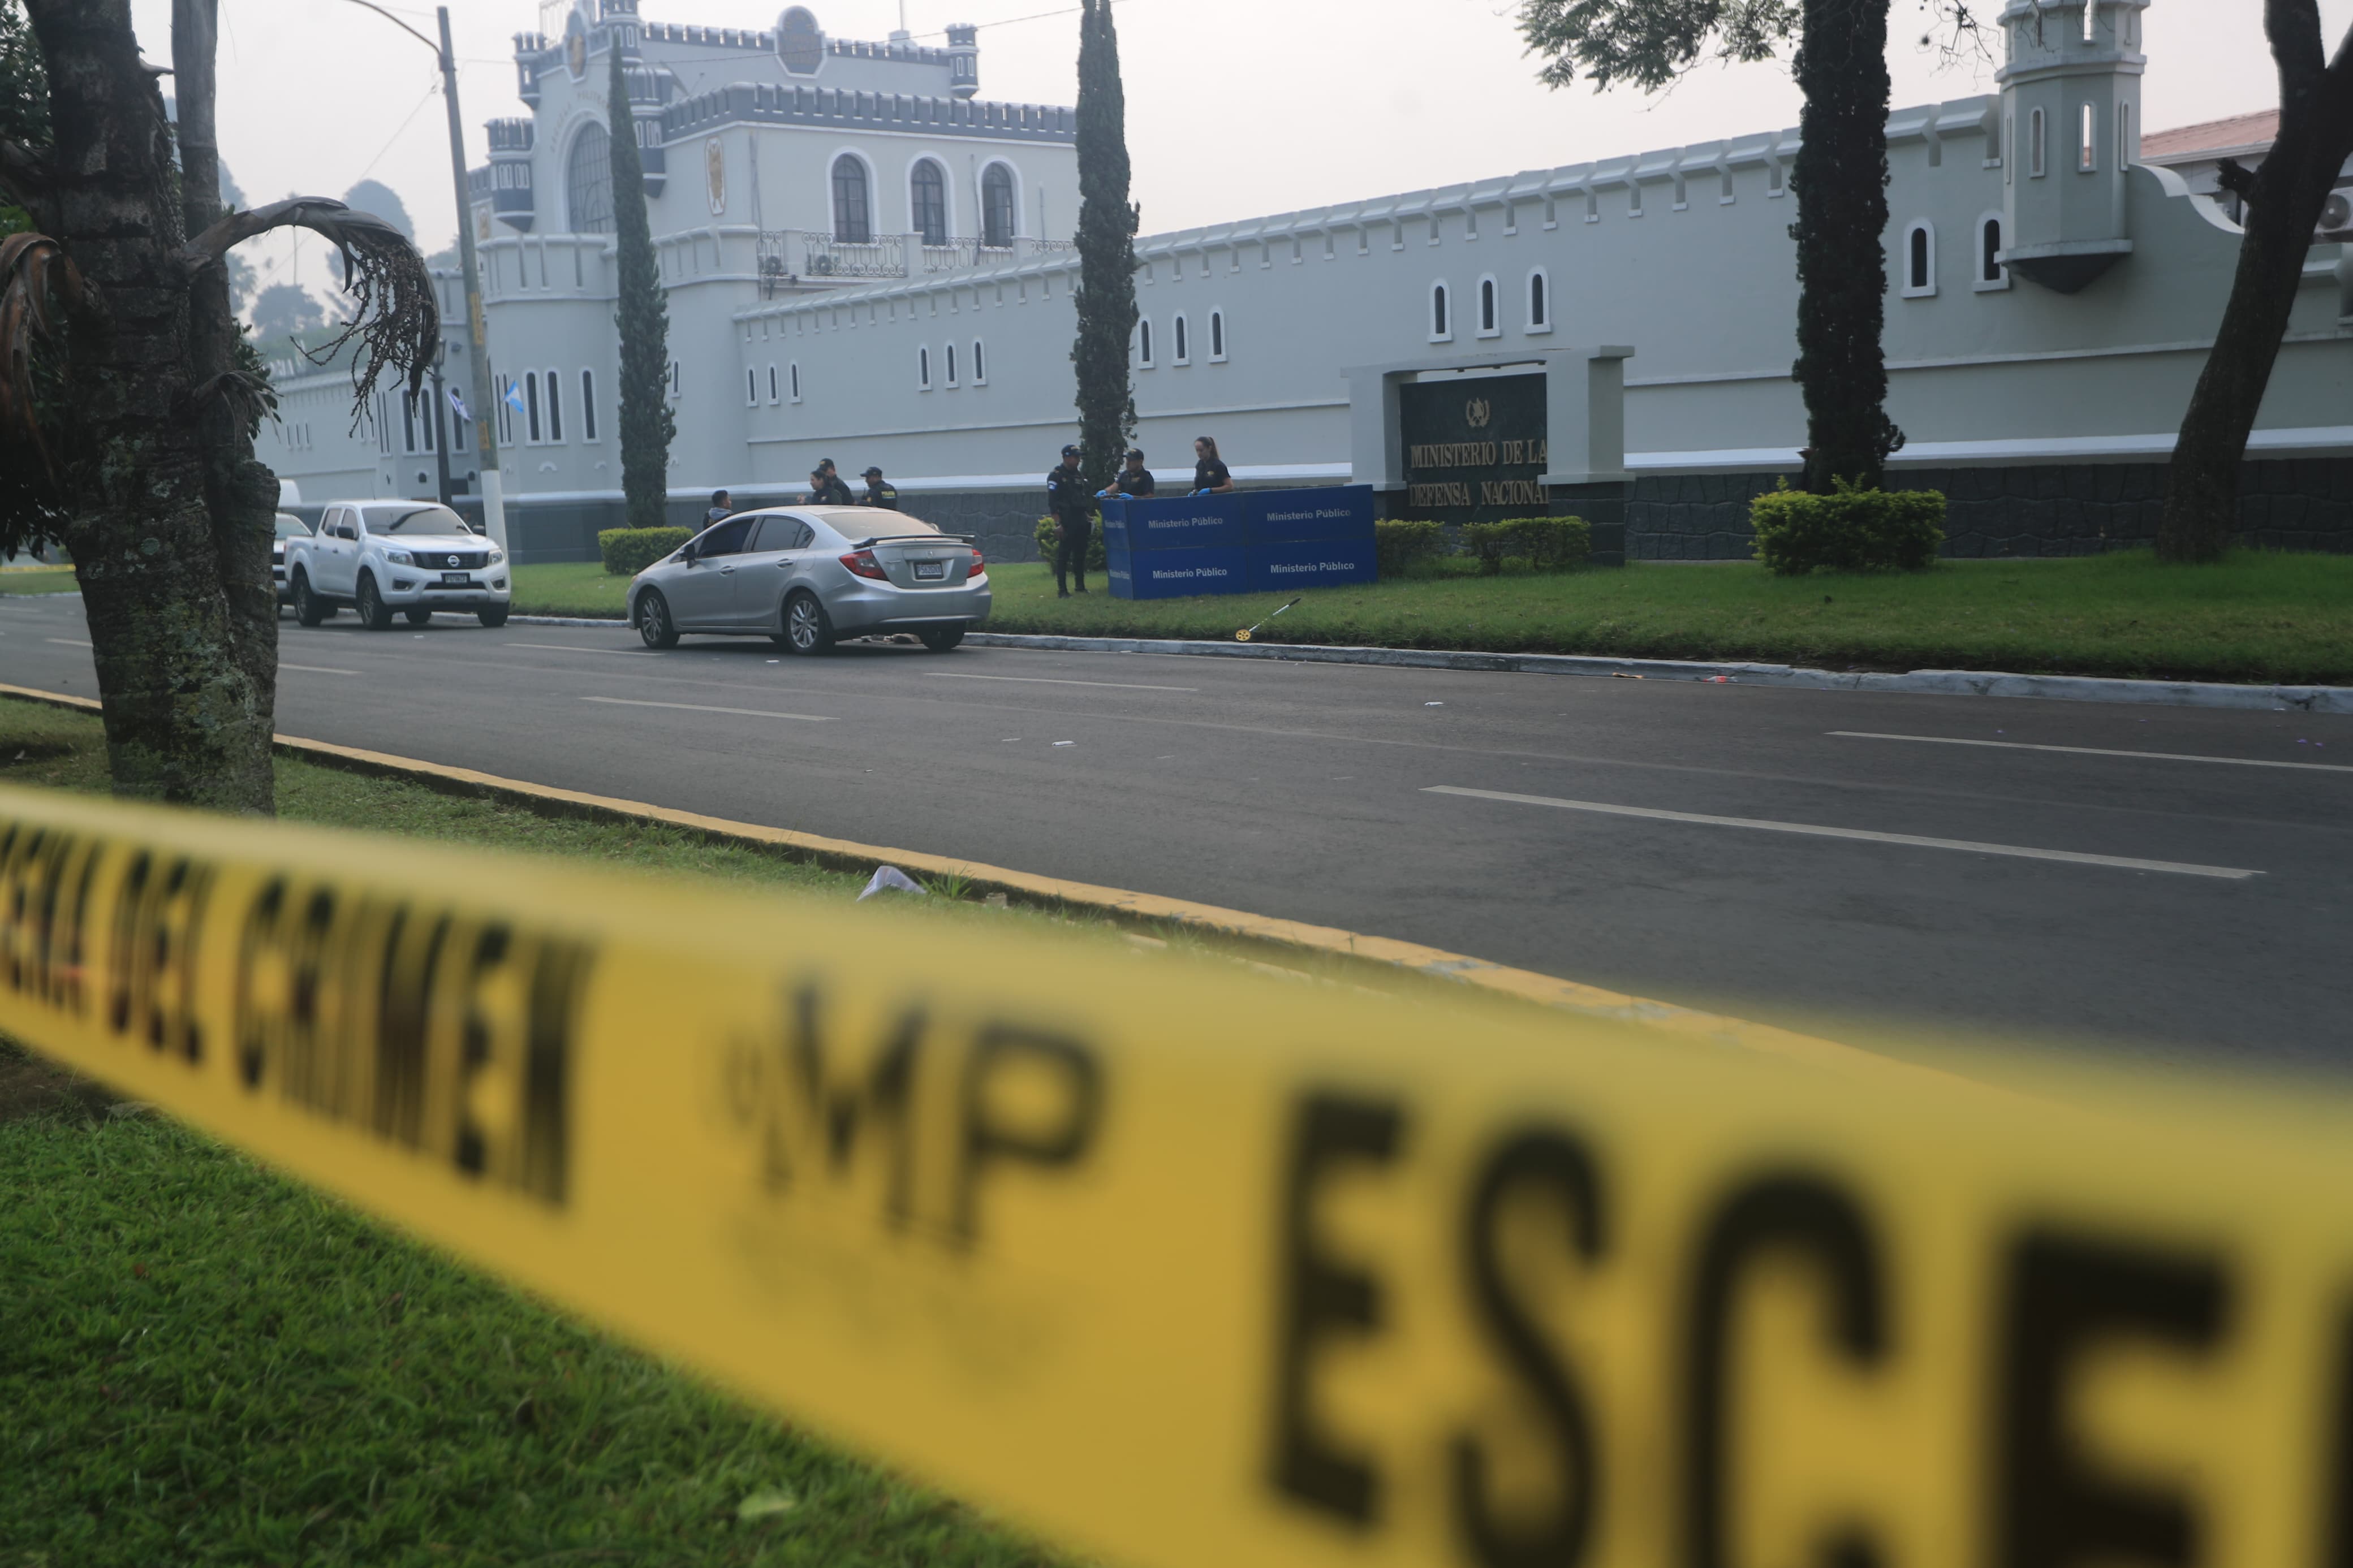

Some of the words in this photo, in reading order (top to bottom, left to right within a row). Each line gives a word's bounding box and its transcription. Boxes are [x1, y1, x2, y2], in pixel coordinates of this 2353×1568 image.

[1410, 441, 1496, 468] MINISTERIO
[1502, 440, 1523, 464] DE
[1527, 439, 1548, 464] LA
[1408, 482, 1471, 507] DEFENSA
[1148, 519, 1189, 528] Ministerio
[1192, 516, 1222, 526] Público
[1267, 511, 1313, 521] Ministerio
[1316, 508, 1351, 518] Público
[1153, 569, 1193, 578] Ministerio
[1196, 568, 1227, 577] Público
[1270, 563, 1317, 573] Ministerio
[1320, 561, 1354, 571] Público
[761, 978, 1114, 1255] MP
[1264, 1077, 2353, 1568] ESCE
